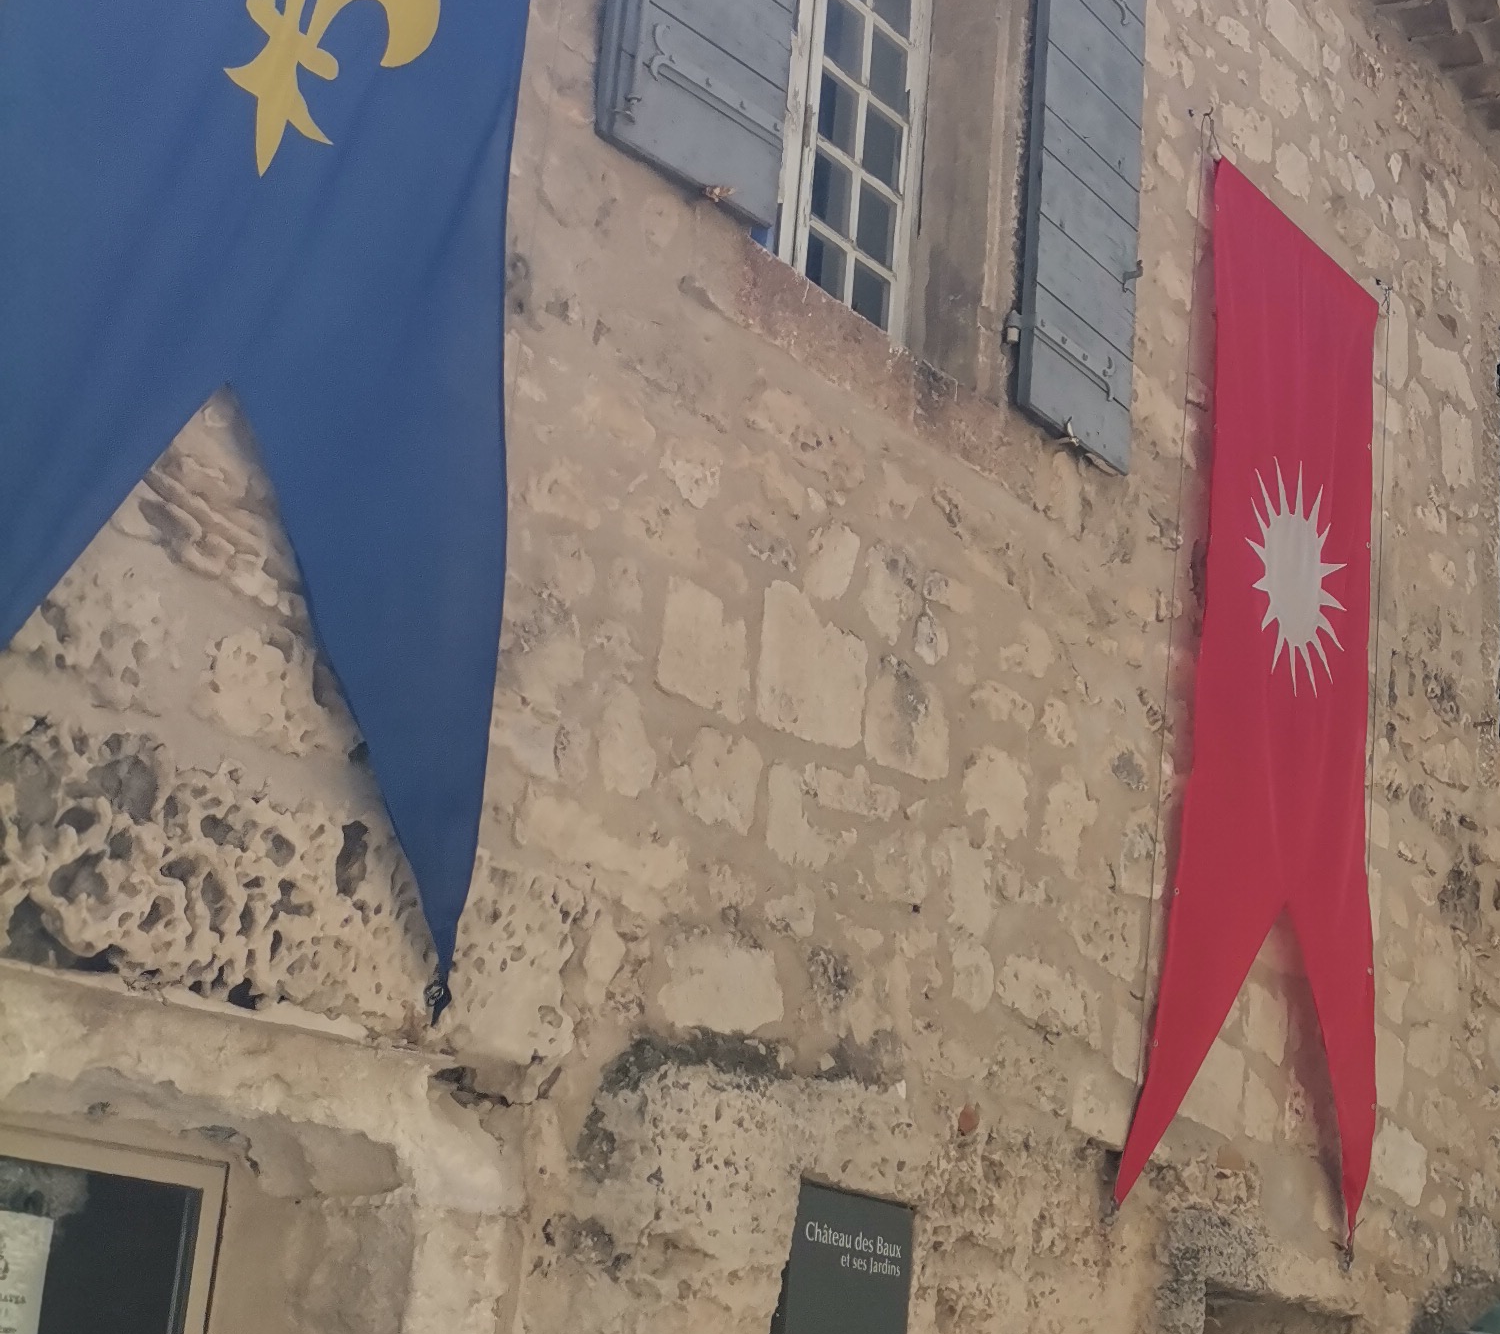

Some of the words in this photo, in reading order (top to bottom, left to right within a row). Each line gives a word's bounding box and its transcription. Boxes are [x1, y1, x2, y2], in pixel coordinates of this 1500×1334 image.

[805, 1221, 852, 1249] Château
[854, 1231, 874, 1253] des
[876, 1235, 902, 1258] Baux
[841, 1253, 850, 1268] et
[852, 1256, 867, 1271] ses
[868, 1257, 901, 1277] Jardins
